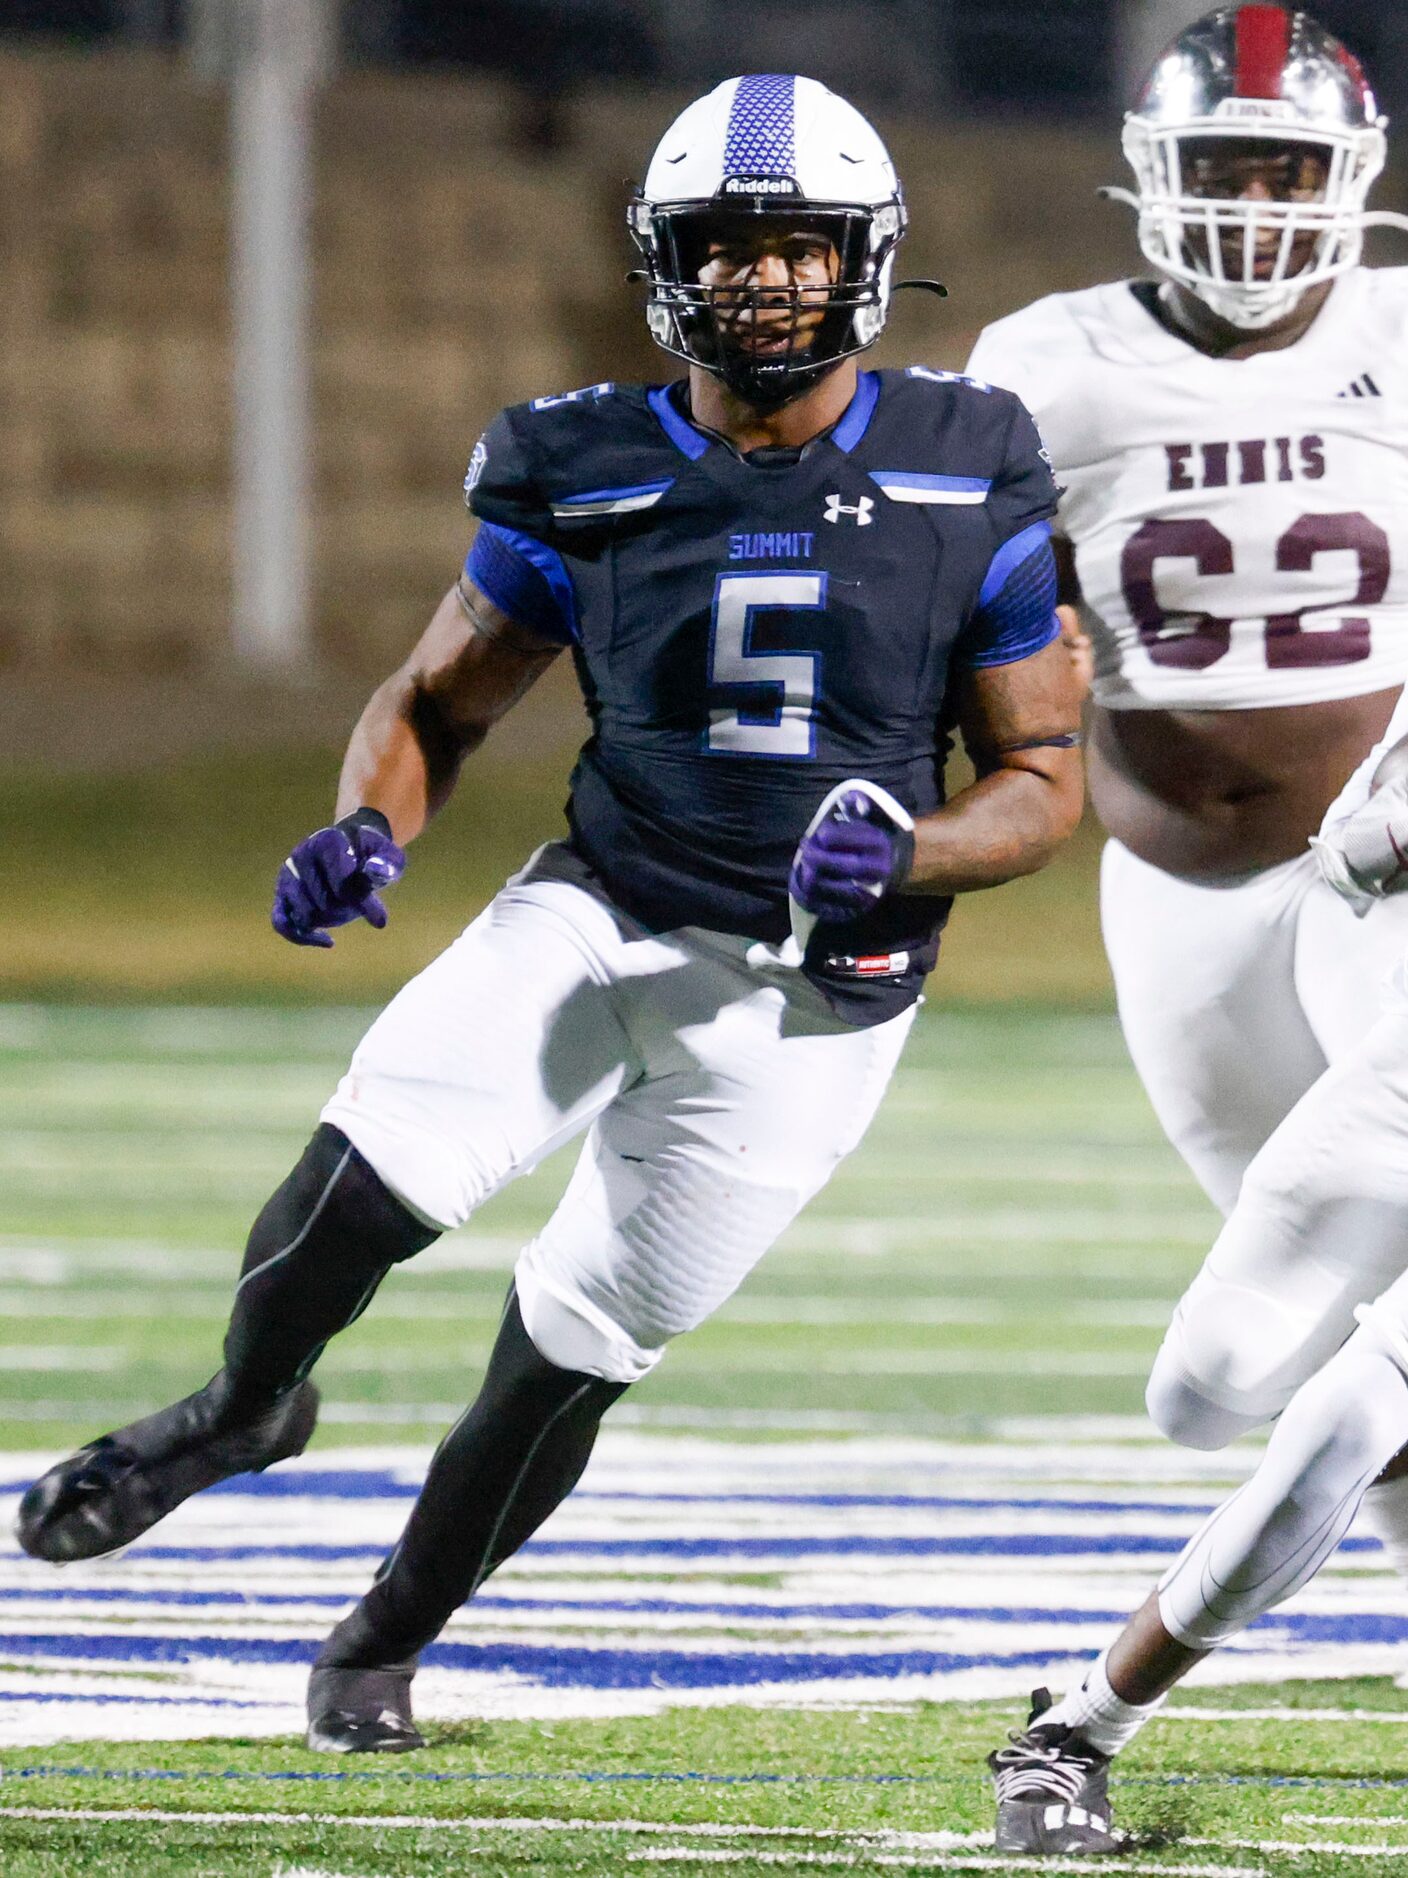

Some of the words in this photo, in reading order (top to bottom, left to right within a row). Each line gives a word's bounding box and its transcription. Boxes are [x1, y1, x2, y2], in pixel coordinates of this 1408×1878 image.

[725, 176, 794, 193] Riddell
[1164, 434, 1325, 492] ENNIS
[728, 532, 814, 560] SUMMIT
[1120, 511, 1391, 670] 62
[706, 569, 828, 759] 5
